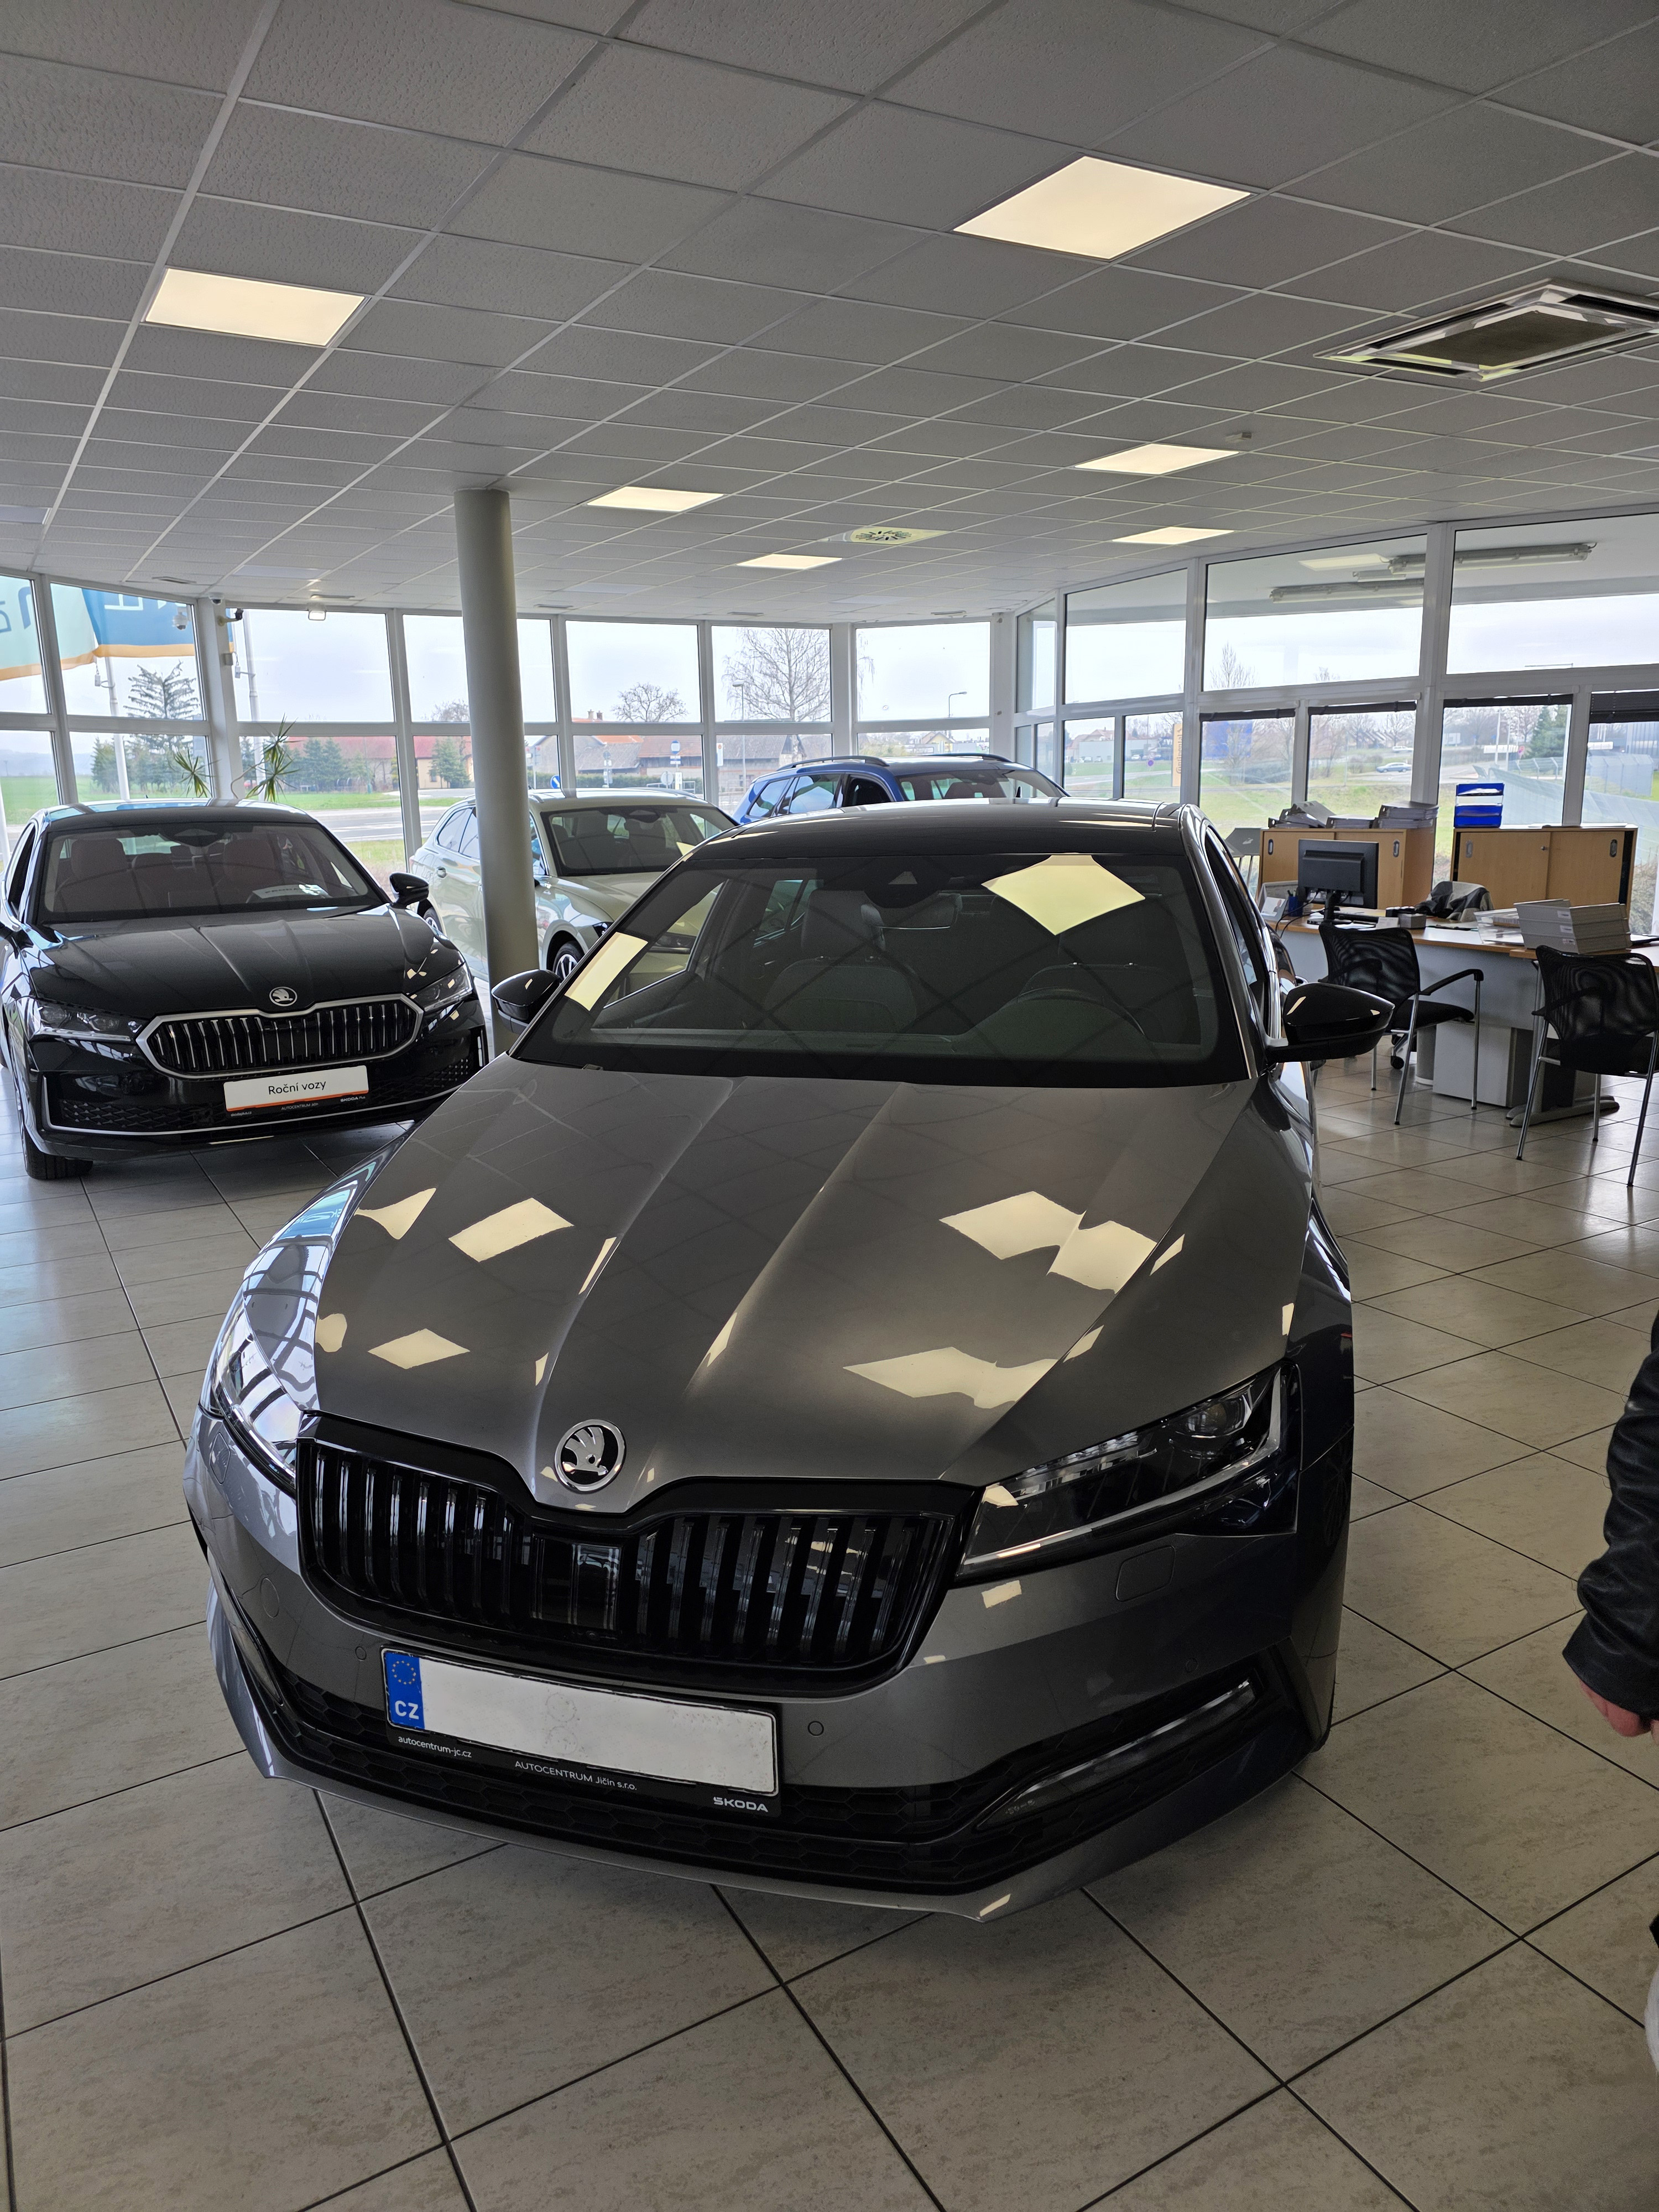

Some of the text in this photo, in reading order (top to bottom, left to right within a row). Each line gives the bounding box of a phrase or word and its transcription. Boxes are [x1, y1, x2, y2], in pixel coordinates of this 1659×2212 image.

[269, 1081, 326, 1095] Roční vozy
[395, 1700, 419, 1720] CZ
[398, 1736, 472, 1758] autocentrum-jc.cz
[515, 1761, 637, 1791] AUTOCENTRUM Jičín s.r.o.
